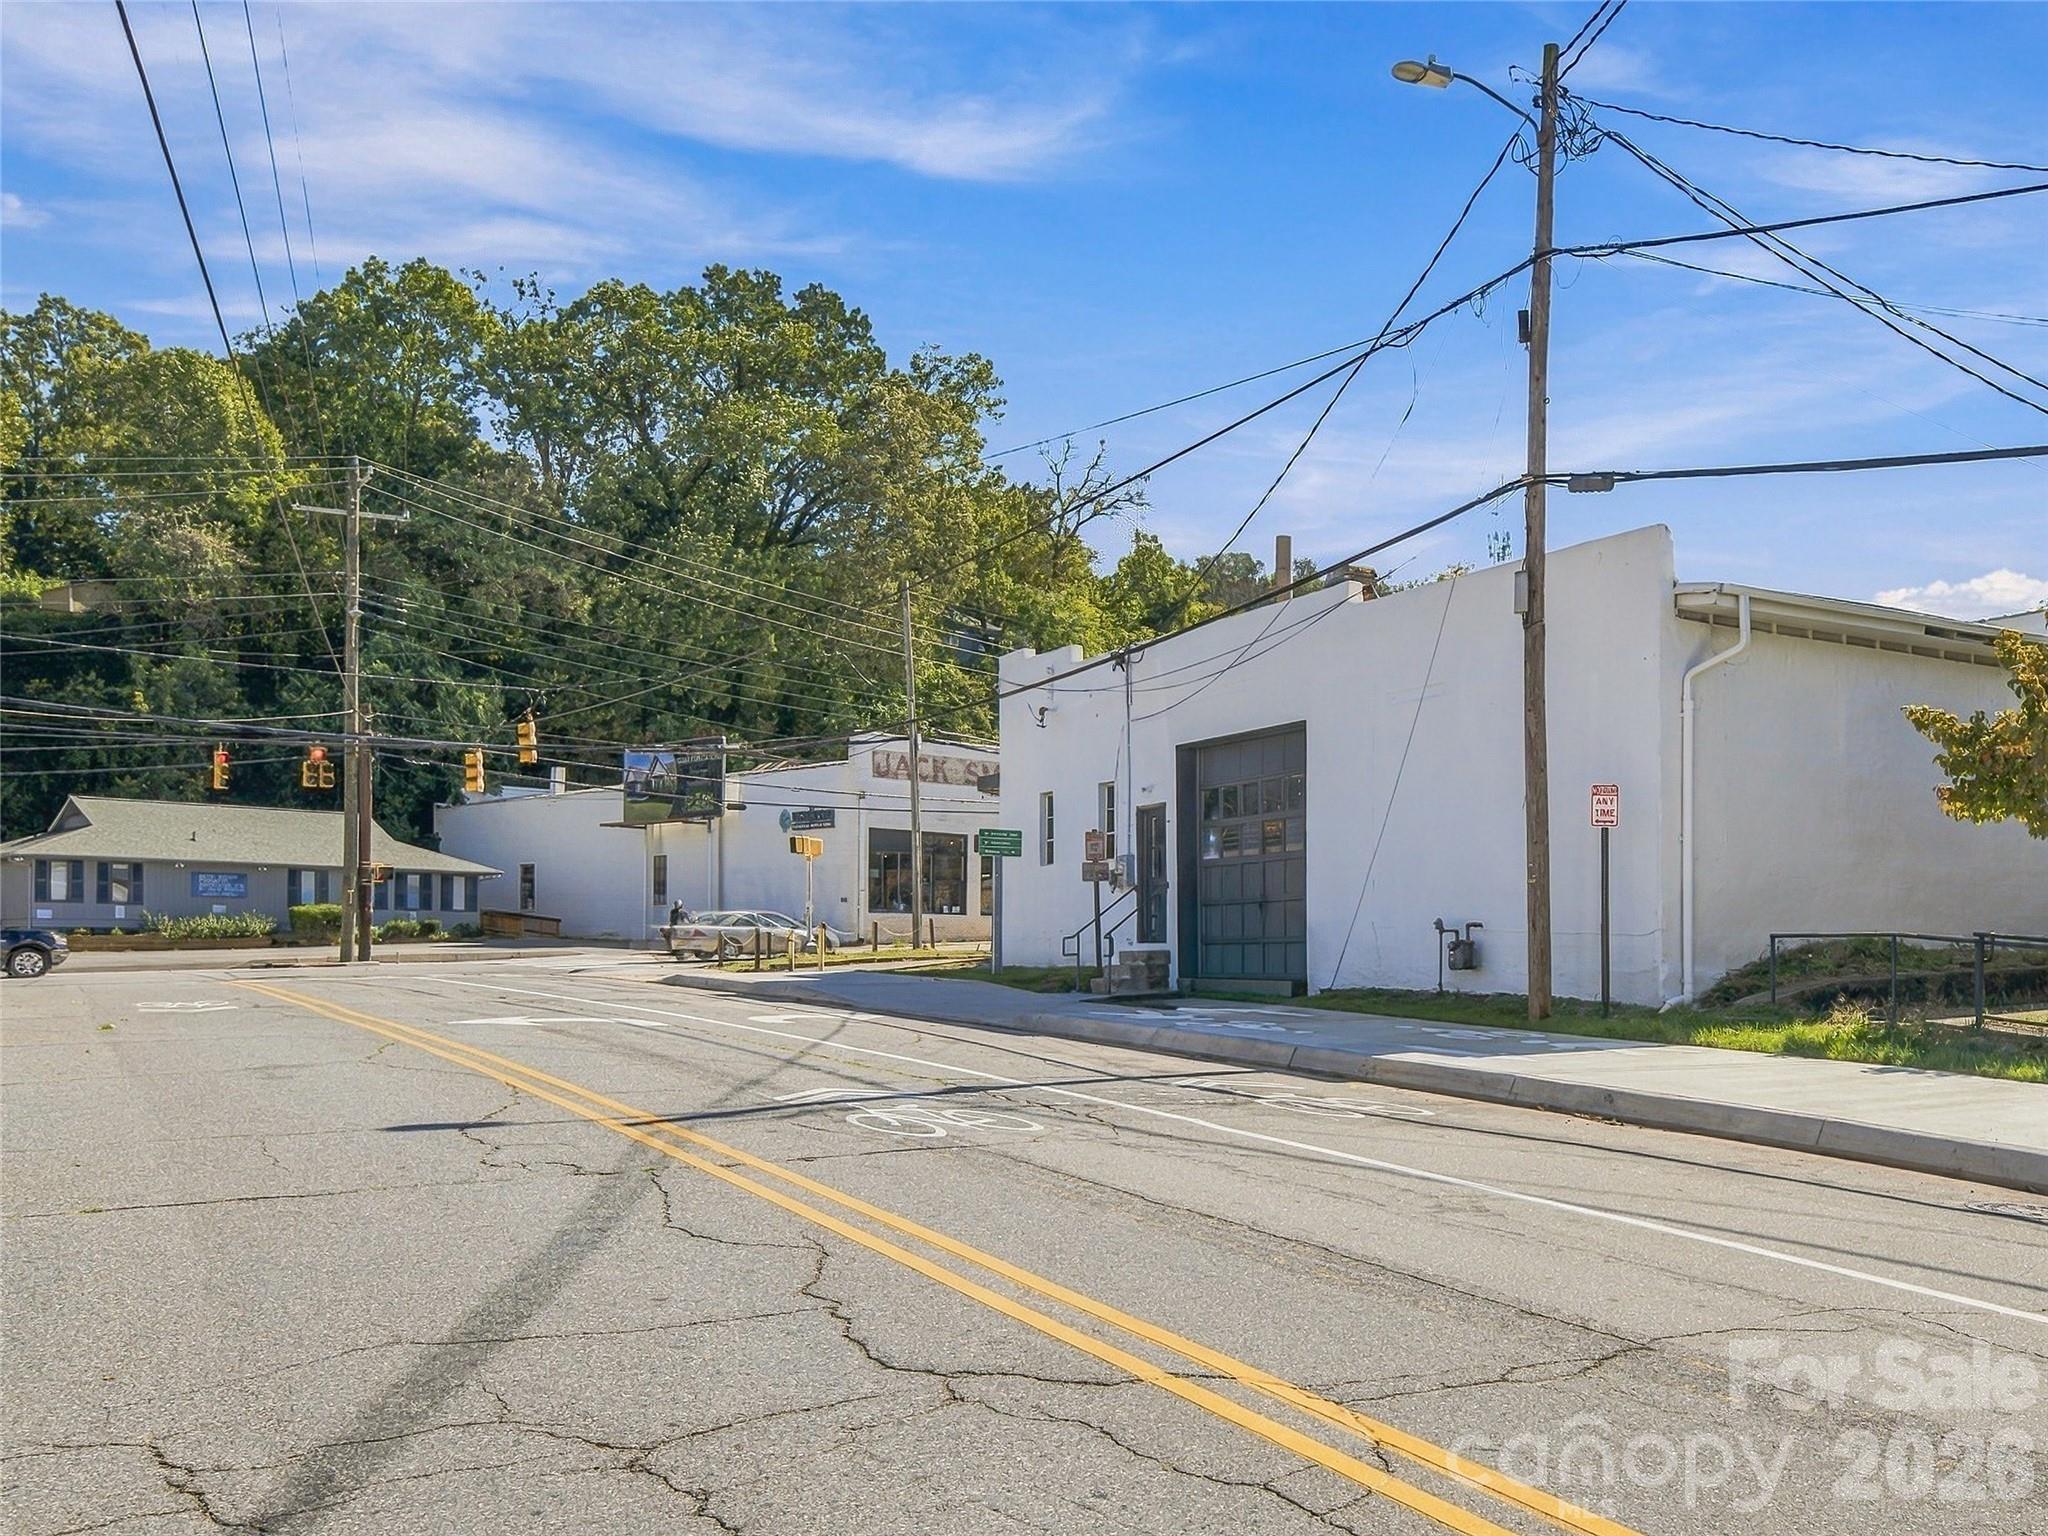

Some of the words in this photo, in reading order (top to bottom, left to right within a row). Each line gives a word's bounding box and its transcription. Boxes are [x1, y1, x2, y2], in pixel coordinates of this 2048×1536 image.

[875, 752, 947, 784] JACK
[1596, 797, 1614, 805] ANY
[1595, 809, 1615, 817] TIME
